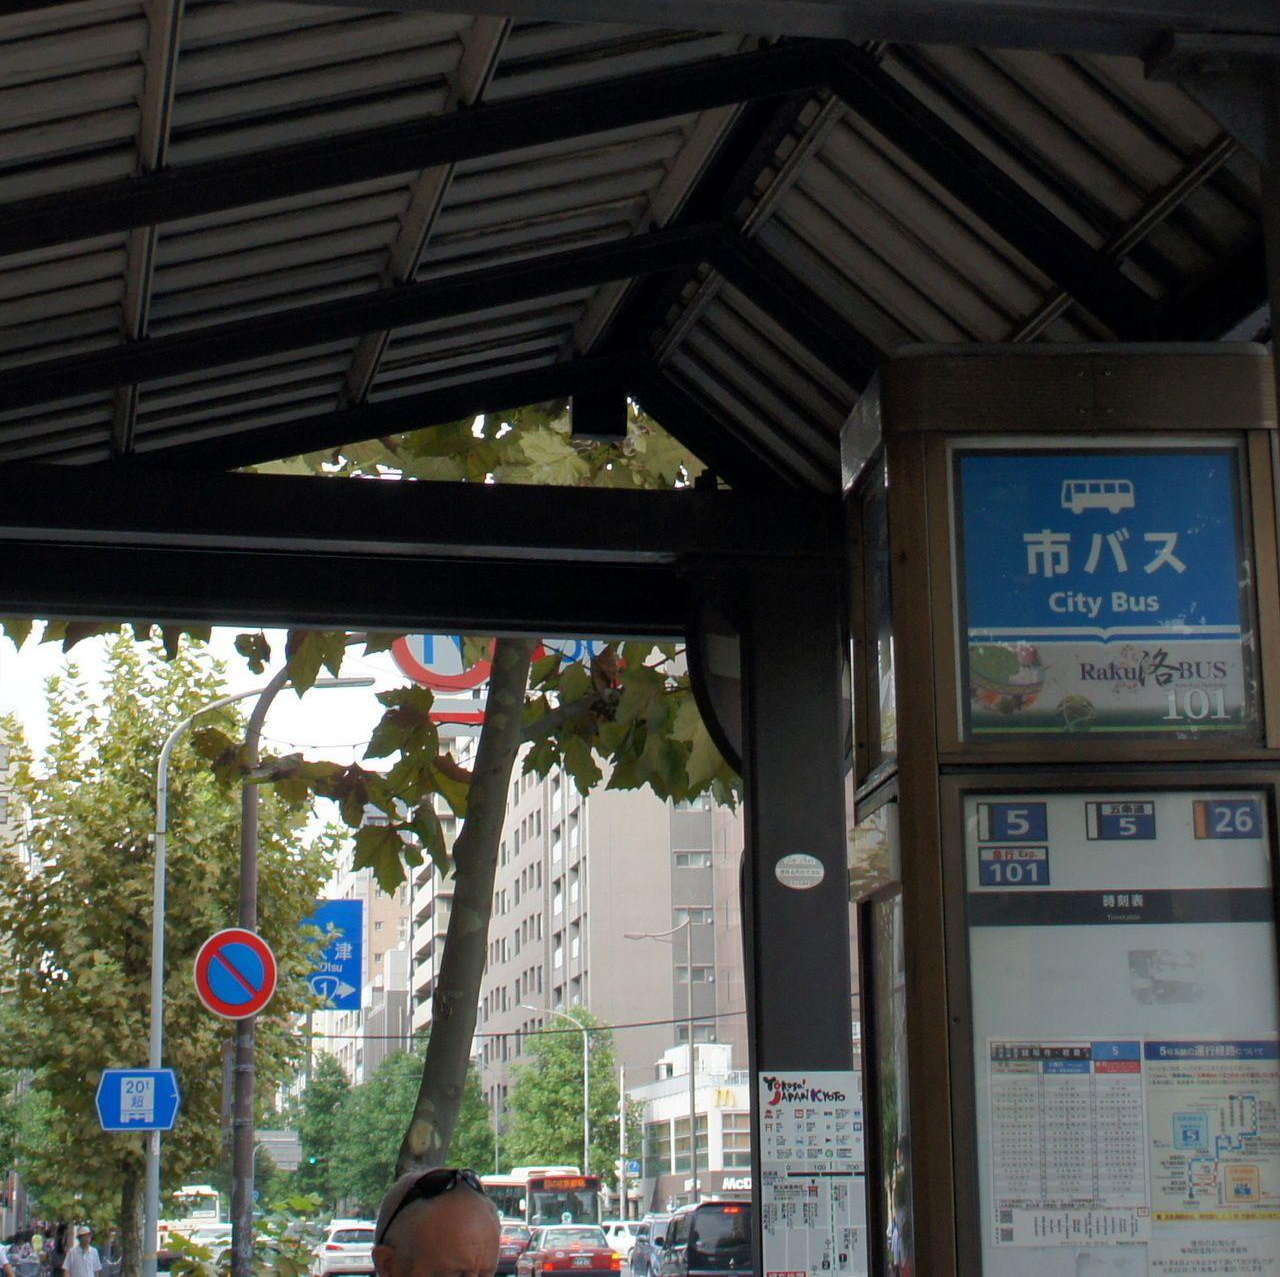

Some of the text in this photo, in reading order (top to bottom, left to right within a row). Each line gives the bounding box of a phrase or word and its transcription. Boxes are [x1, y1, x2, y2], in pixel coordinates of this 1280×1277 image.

[1023, 528, 1187, 578] 市バス
[1049, 591, 1160, 618] City Bus
[1163, 689, 1231, 721] 101
[1007, 810, 1030, 835] 5
[1119, 818, 1137, 836] 5
[1214, 807, 1253, 833] 26
[989, 863, 1039, 882] 101
[1102, 894, 1144, 908] 時刻表
